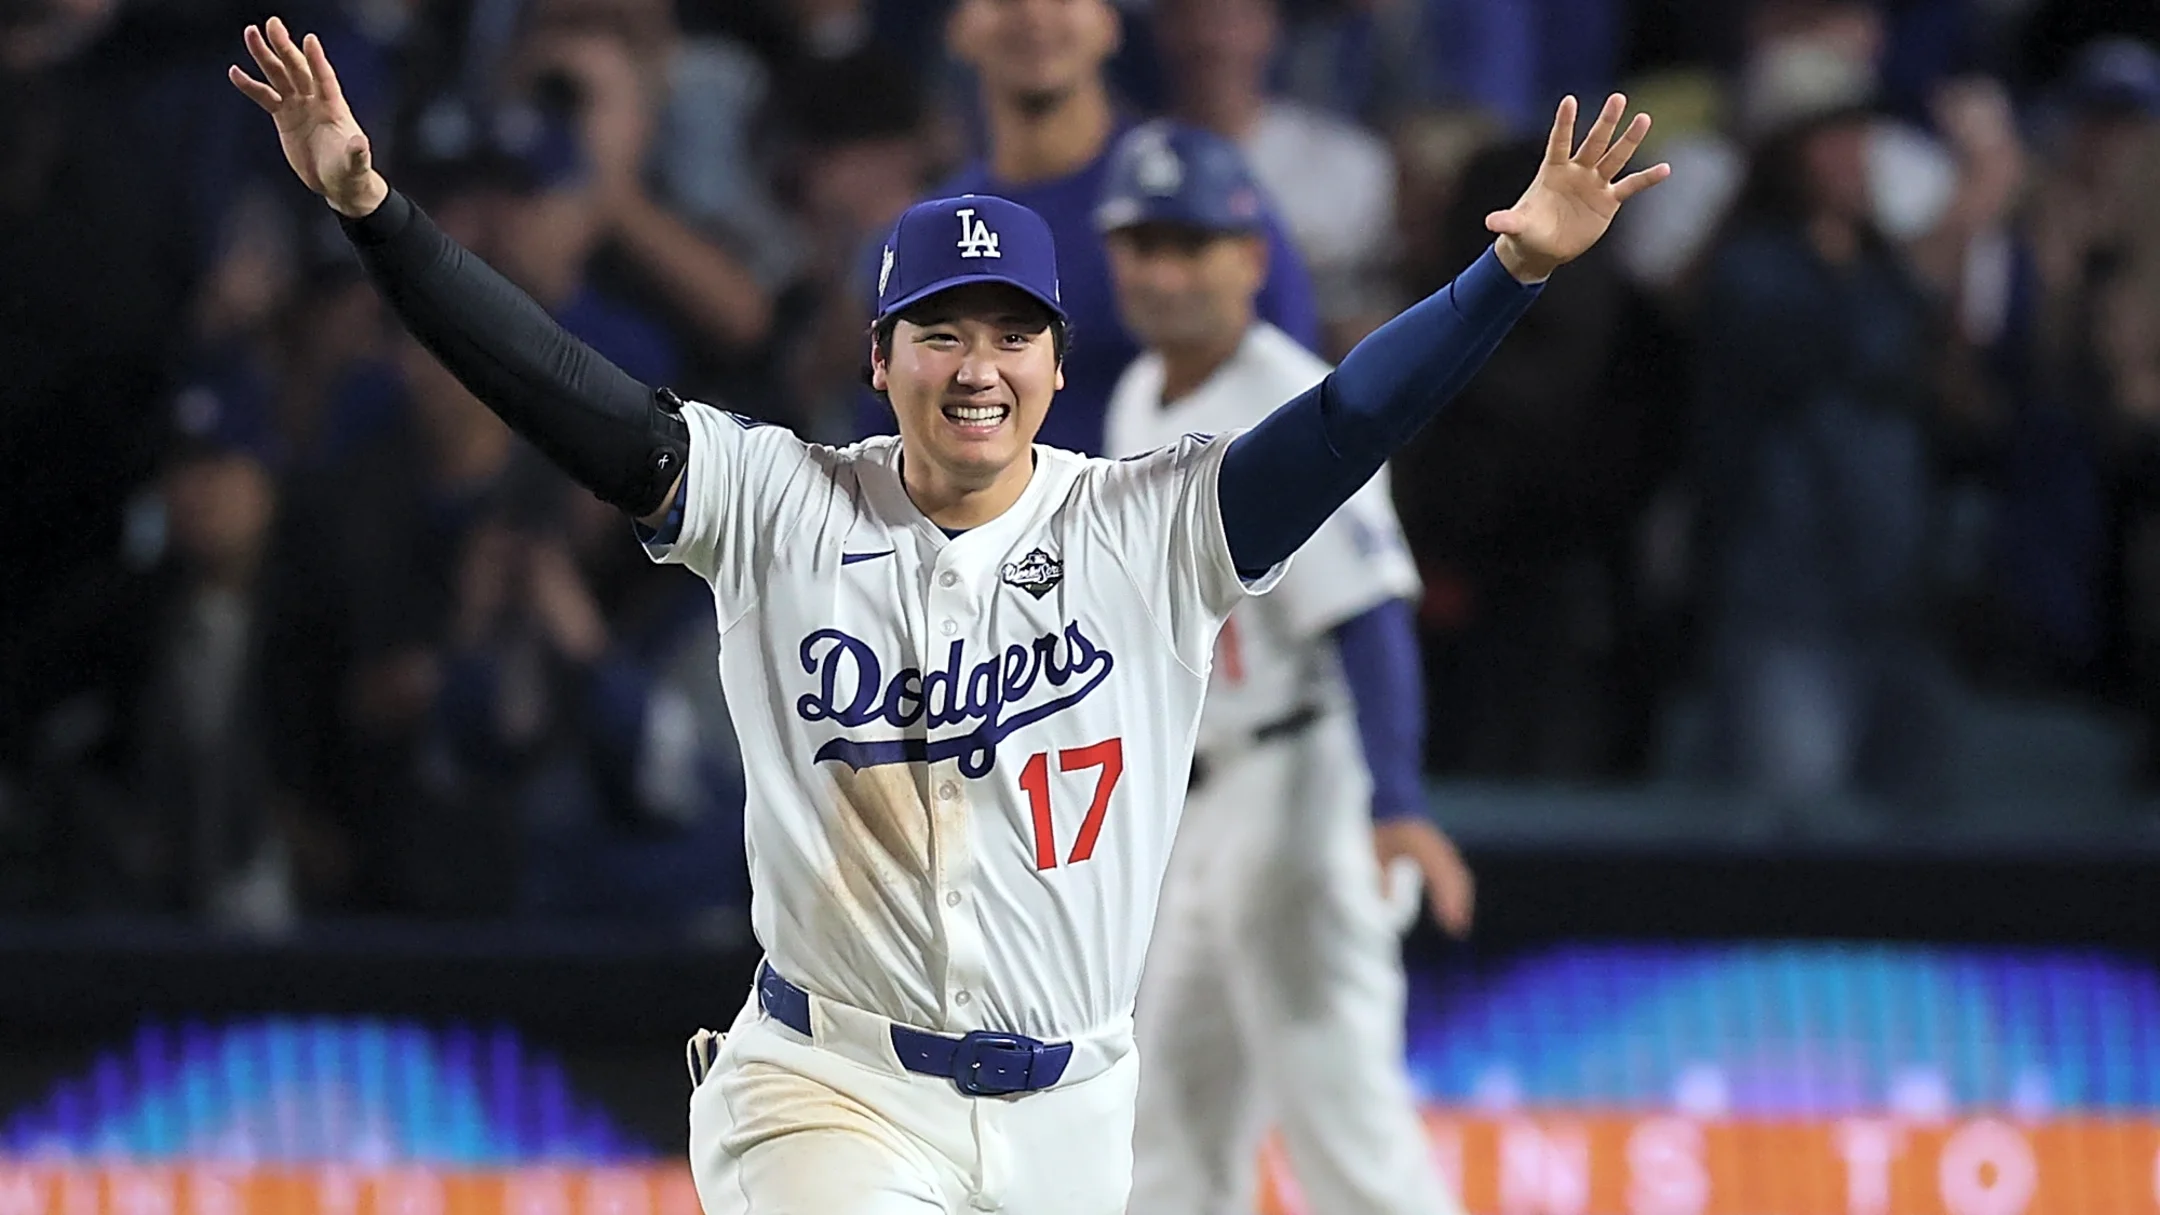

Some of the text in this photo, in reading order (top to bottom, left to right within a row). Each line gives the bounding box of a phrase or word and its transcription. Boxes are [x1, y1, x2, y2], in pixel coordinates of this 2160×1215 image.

[956, 208, 1001, 258] LA
[797, 619, 1114, 779] Dodgers
[1018, 737, 1124, 871] 17
